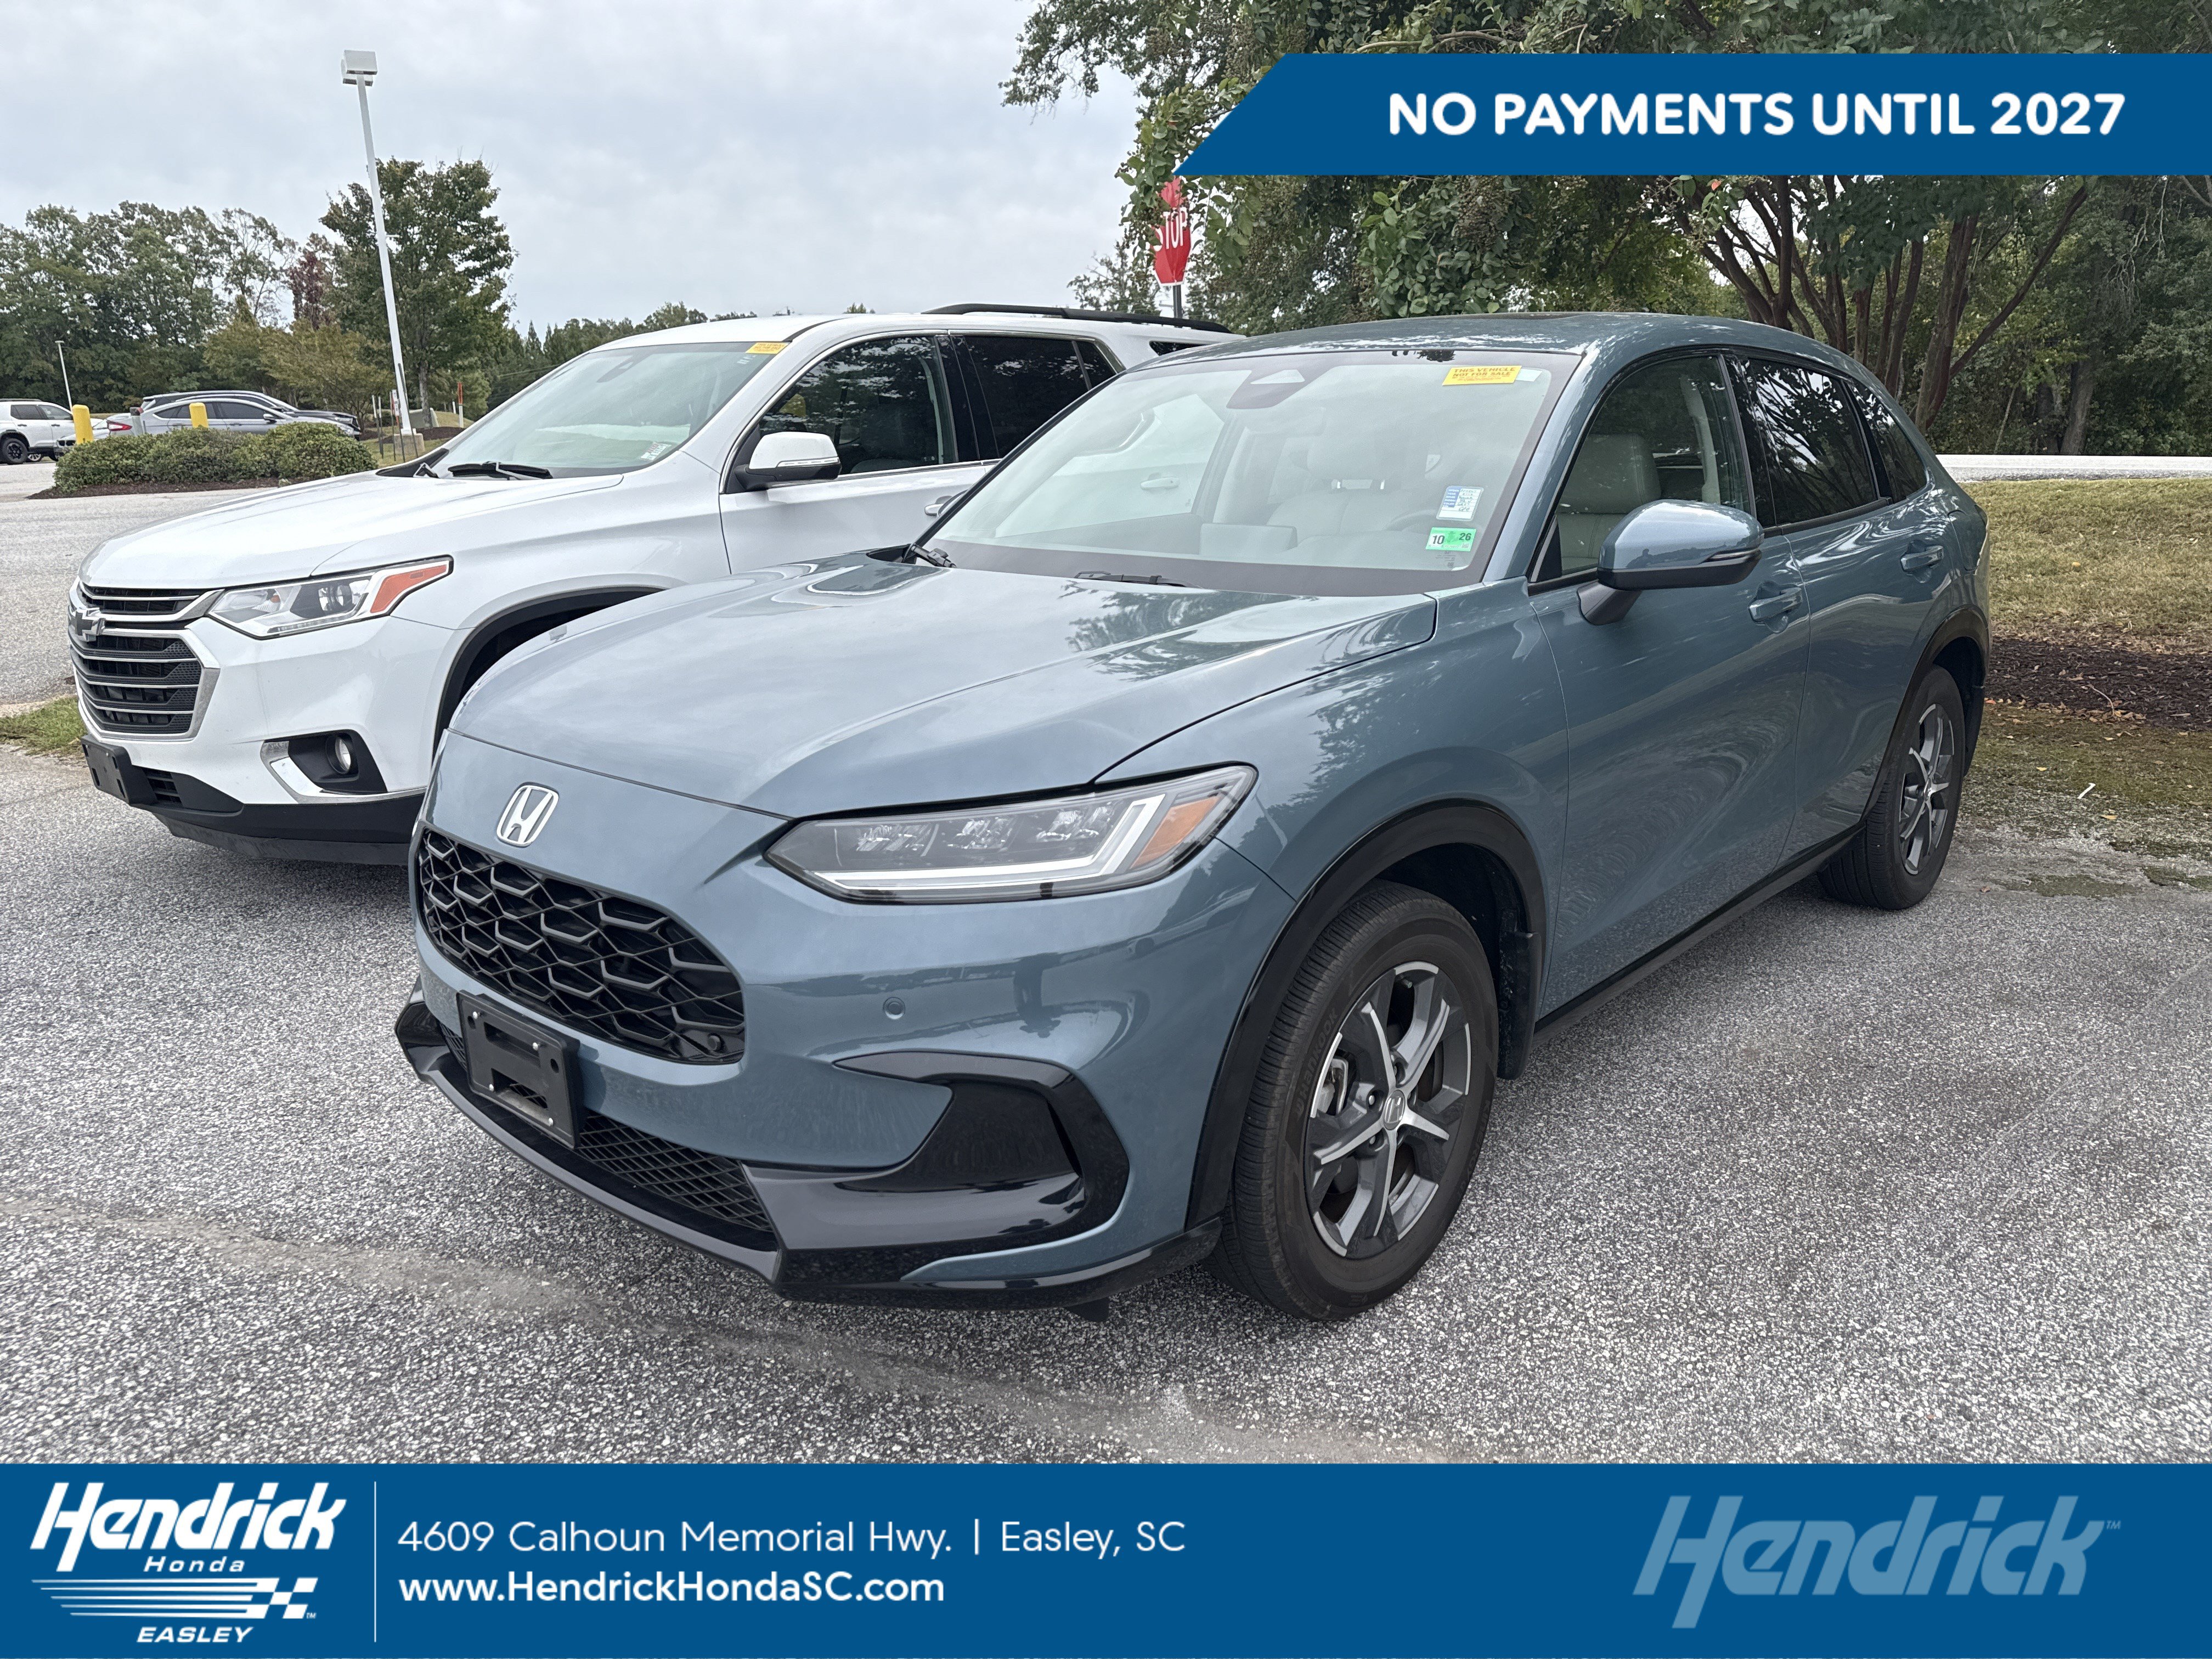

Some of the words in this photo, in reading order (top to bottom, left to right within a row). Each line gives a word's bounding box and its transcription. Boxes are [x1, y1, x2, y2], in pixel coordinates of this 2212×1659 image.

[1153, 206, 1188, 252] STOP
[1432, 535, 1446, 545] 10
[1459, 532, 1472, 541] 26
